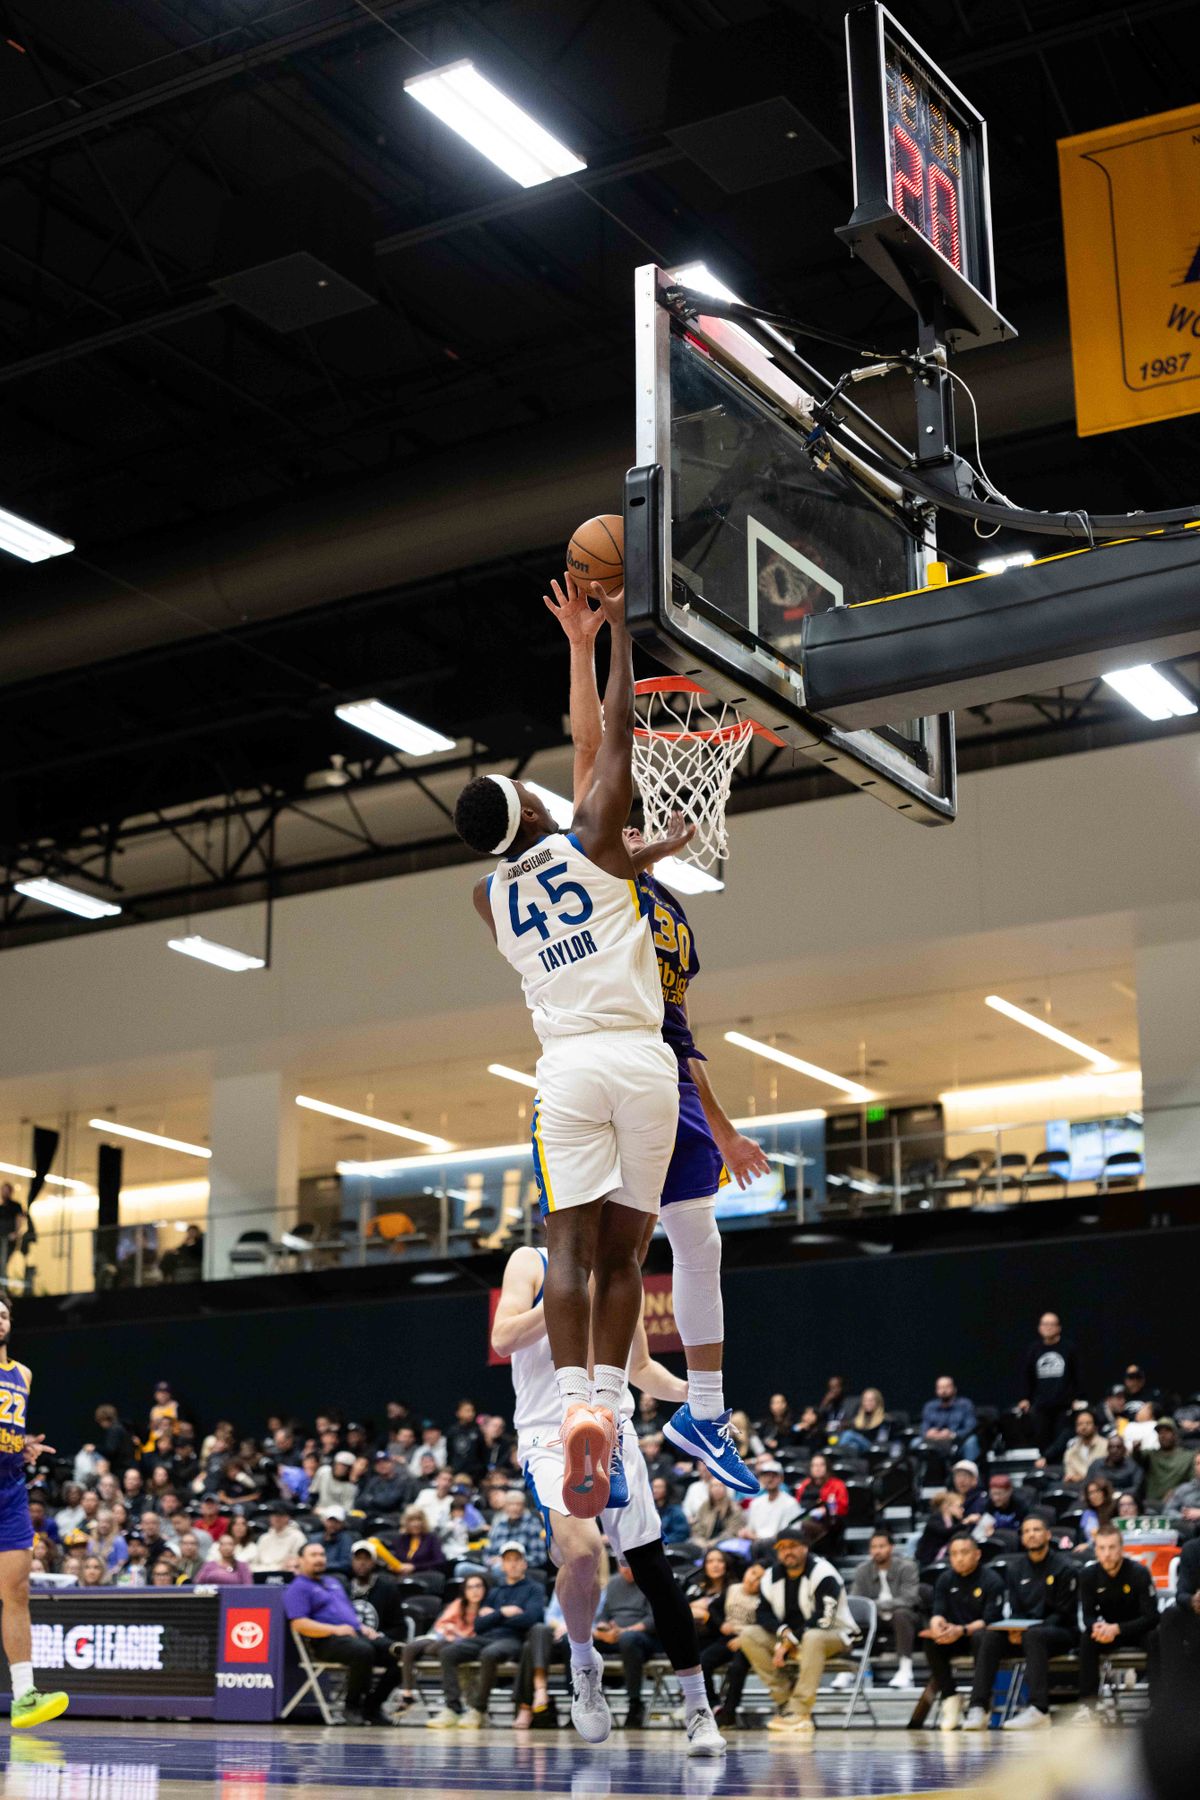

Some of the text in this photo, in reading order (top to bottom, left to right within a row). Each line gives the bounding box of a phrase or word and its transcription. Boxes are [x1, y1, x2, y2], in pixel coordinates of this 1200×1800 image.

[1139, 352, 1191, 381] 1987
[509, 862, 594, 941] 45
[538, 930, 598, 973] TAYLOR
[654, 903, 691, 973] 30
[0, 1388, 26, 1428] 22
[215, 1672, 275, 1689] TOYOTA
